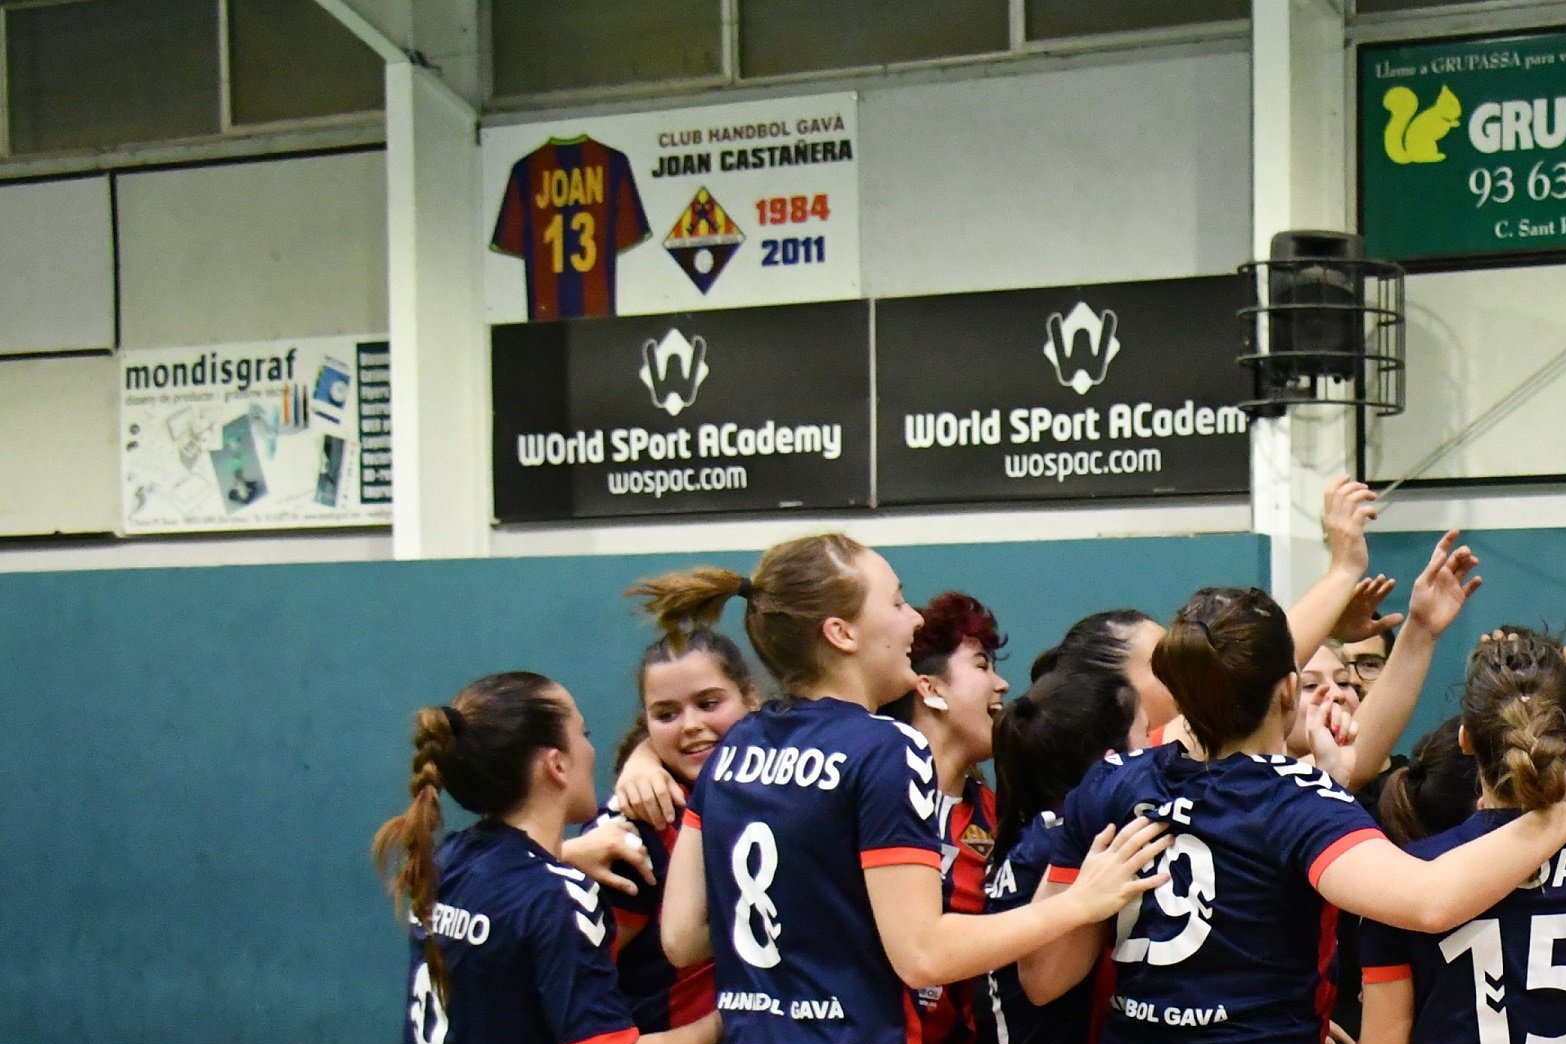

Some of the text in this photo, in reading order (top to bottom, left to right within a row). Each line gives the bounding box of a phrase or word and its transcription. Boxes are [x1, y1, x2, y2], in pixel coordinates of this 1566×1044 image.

[1431, 52, 1522, 74] GRUPASSA
[1525, 53, 1555, 70] para
[658, 130, 702, 148] CLUB
[708, 121, 791, 144] HANDBOL
[651, 139, 853, 178] JOAN CASTAÑERA
[536, 166, 604, 209] JOAN
[1468, 166, 1515, 209] 93
[755, 193, 831, 226] 1984
[543, 212, 597, 273] 13
[1494, 220, 1513, 238] C.
[1518, 218, 1555, 237] Sant
[761, 235, 826, 267] 2011
[126, 347, 297, 391] mondisgraf
[1004, 447, 1162, 482] wospac.com
[607, 465, 748, 499] wospac.com
[732, 821, 782, 969] 8
[791, 995, 845, 1020] GAVÀ
[1163, 1004, 1228, 1027] GAVÀ
